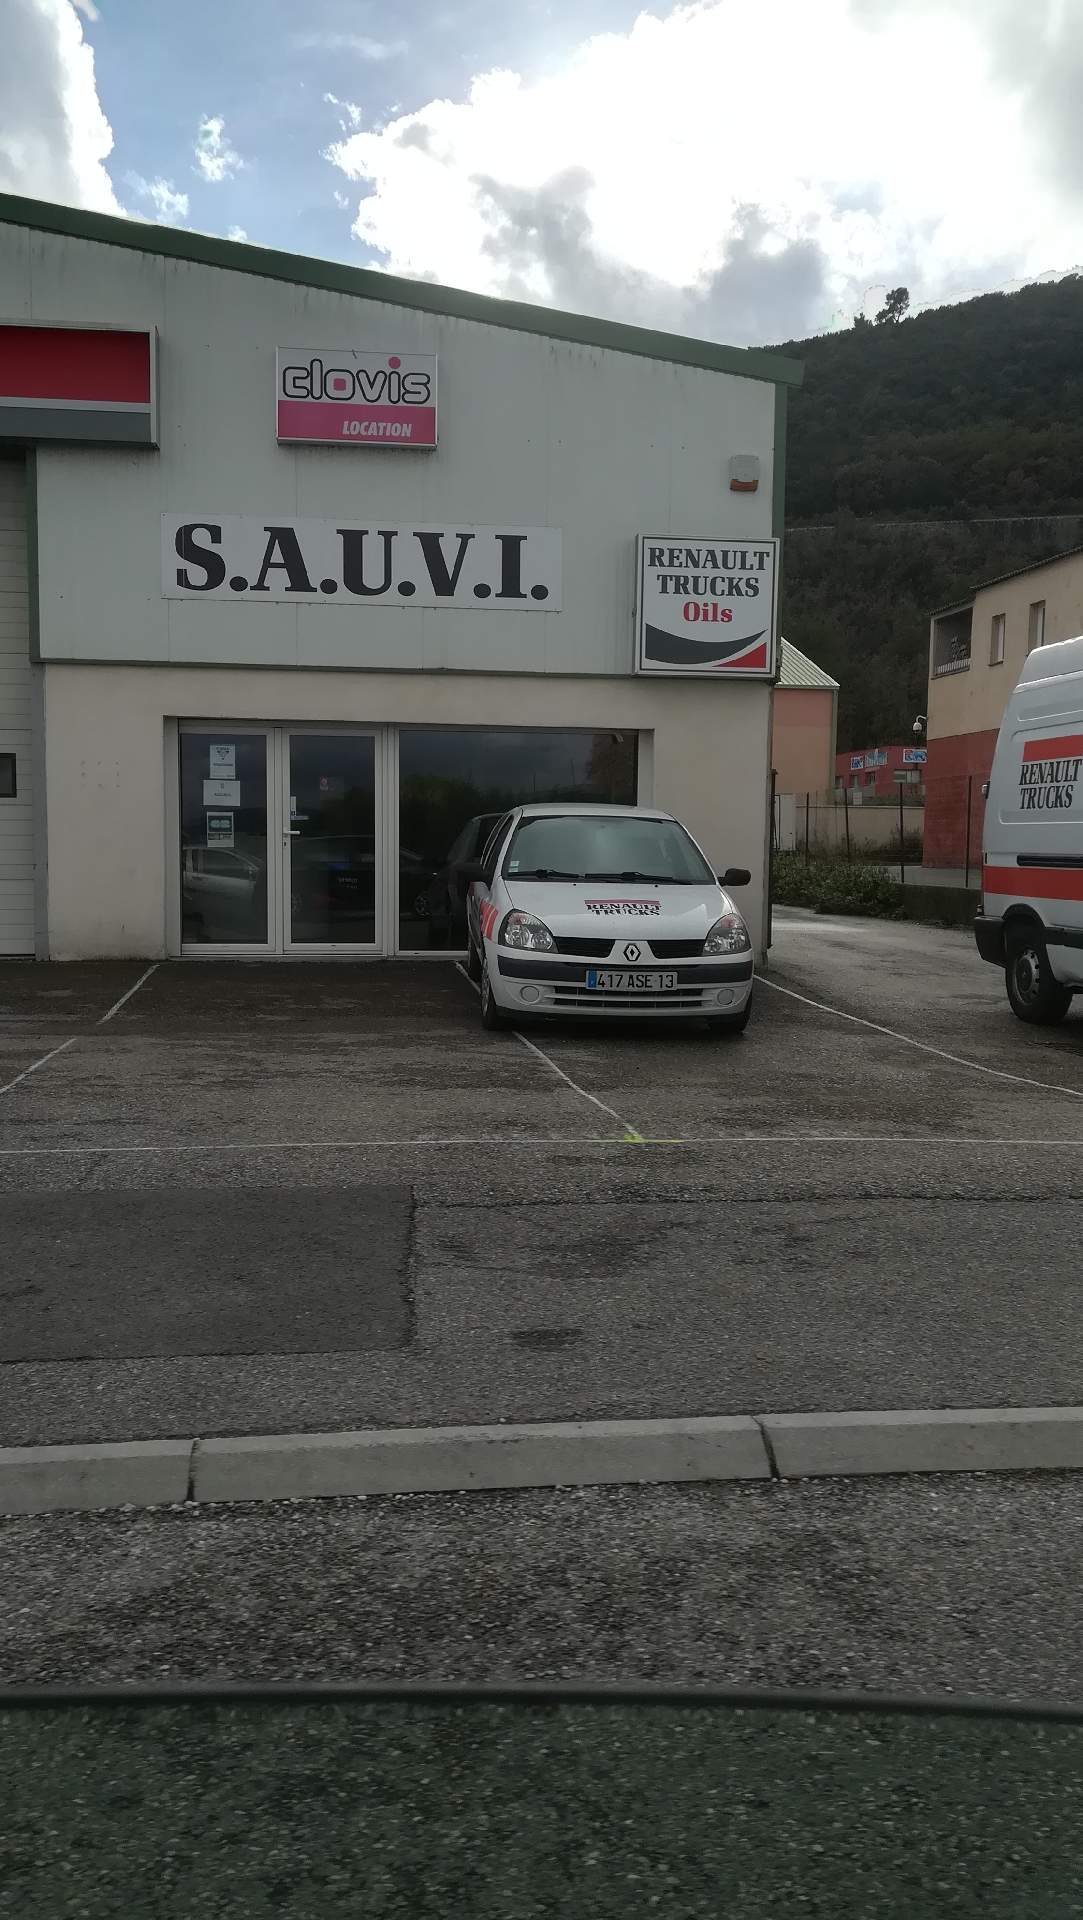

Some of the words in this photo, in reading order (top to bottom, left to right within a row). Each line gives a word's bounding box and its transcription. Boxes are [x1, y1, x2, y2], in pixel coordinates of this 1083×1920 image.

[283, 356, 431, 404] clovis
[342, 420, 412, 437] LOCATION
[175, 523, 549, 600] S.A.U.V.I.
[647, 547, 770, 571] RENAULT
[656, 574, 760, 597] TRUCKS
[683, 601, 733, 623] Oils
[1018, 759, 1083, 785] RENAULT
[1019, 784, 1074, 809] TRUCKS
[586, 903, 661, 911] RENAULT
[591, 908, 661, 916] TRUCKS
[597, 973, 624, 989] 417
[627, 974, 654, 989] ASE
[658, 974, 675, 989] 13
